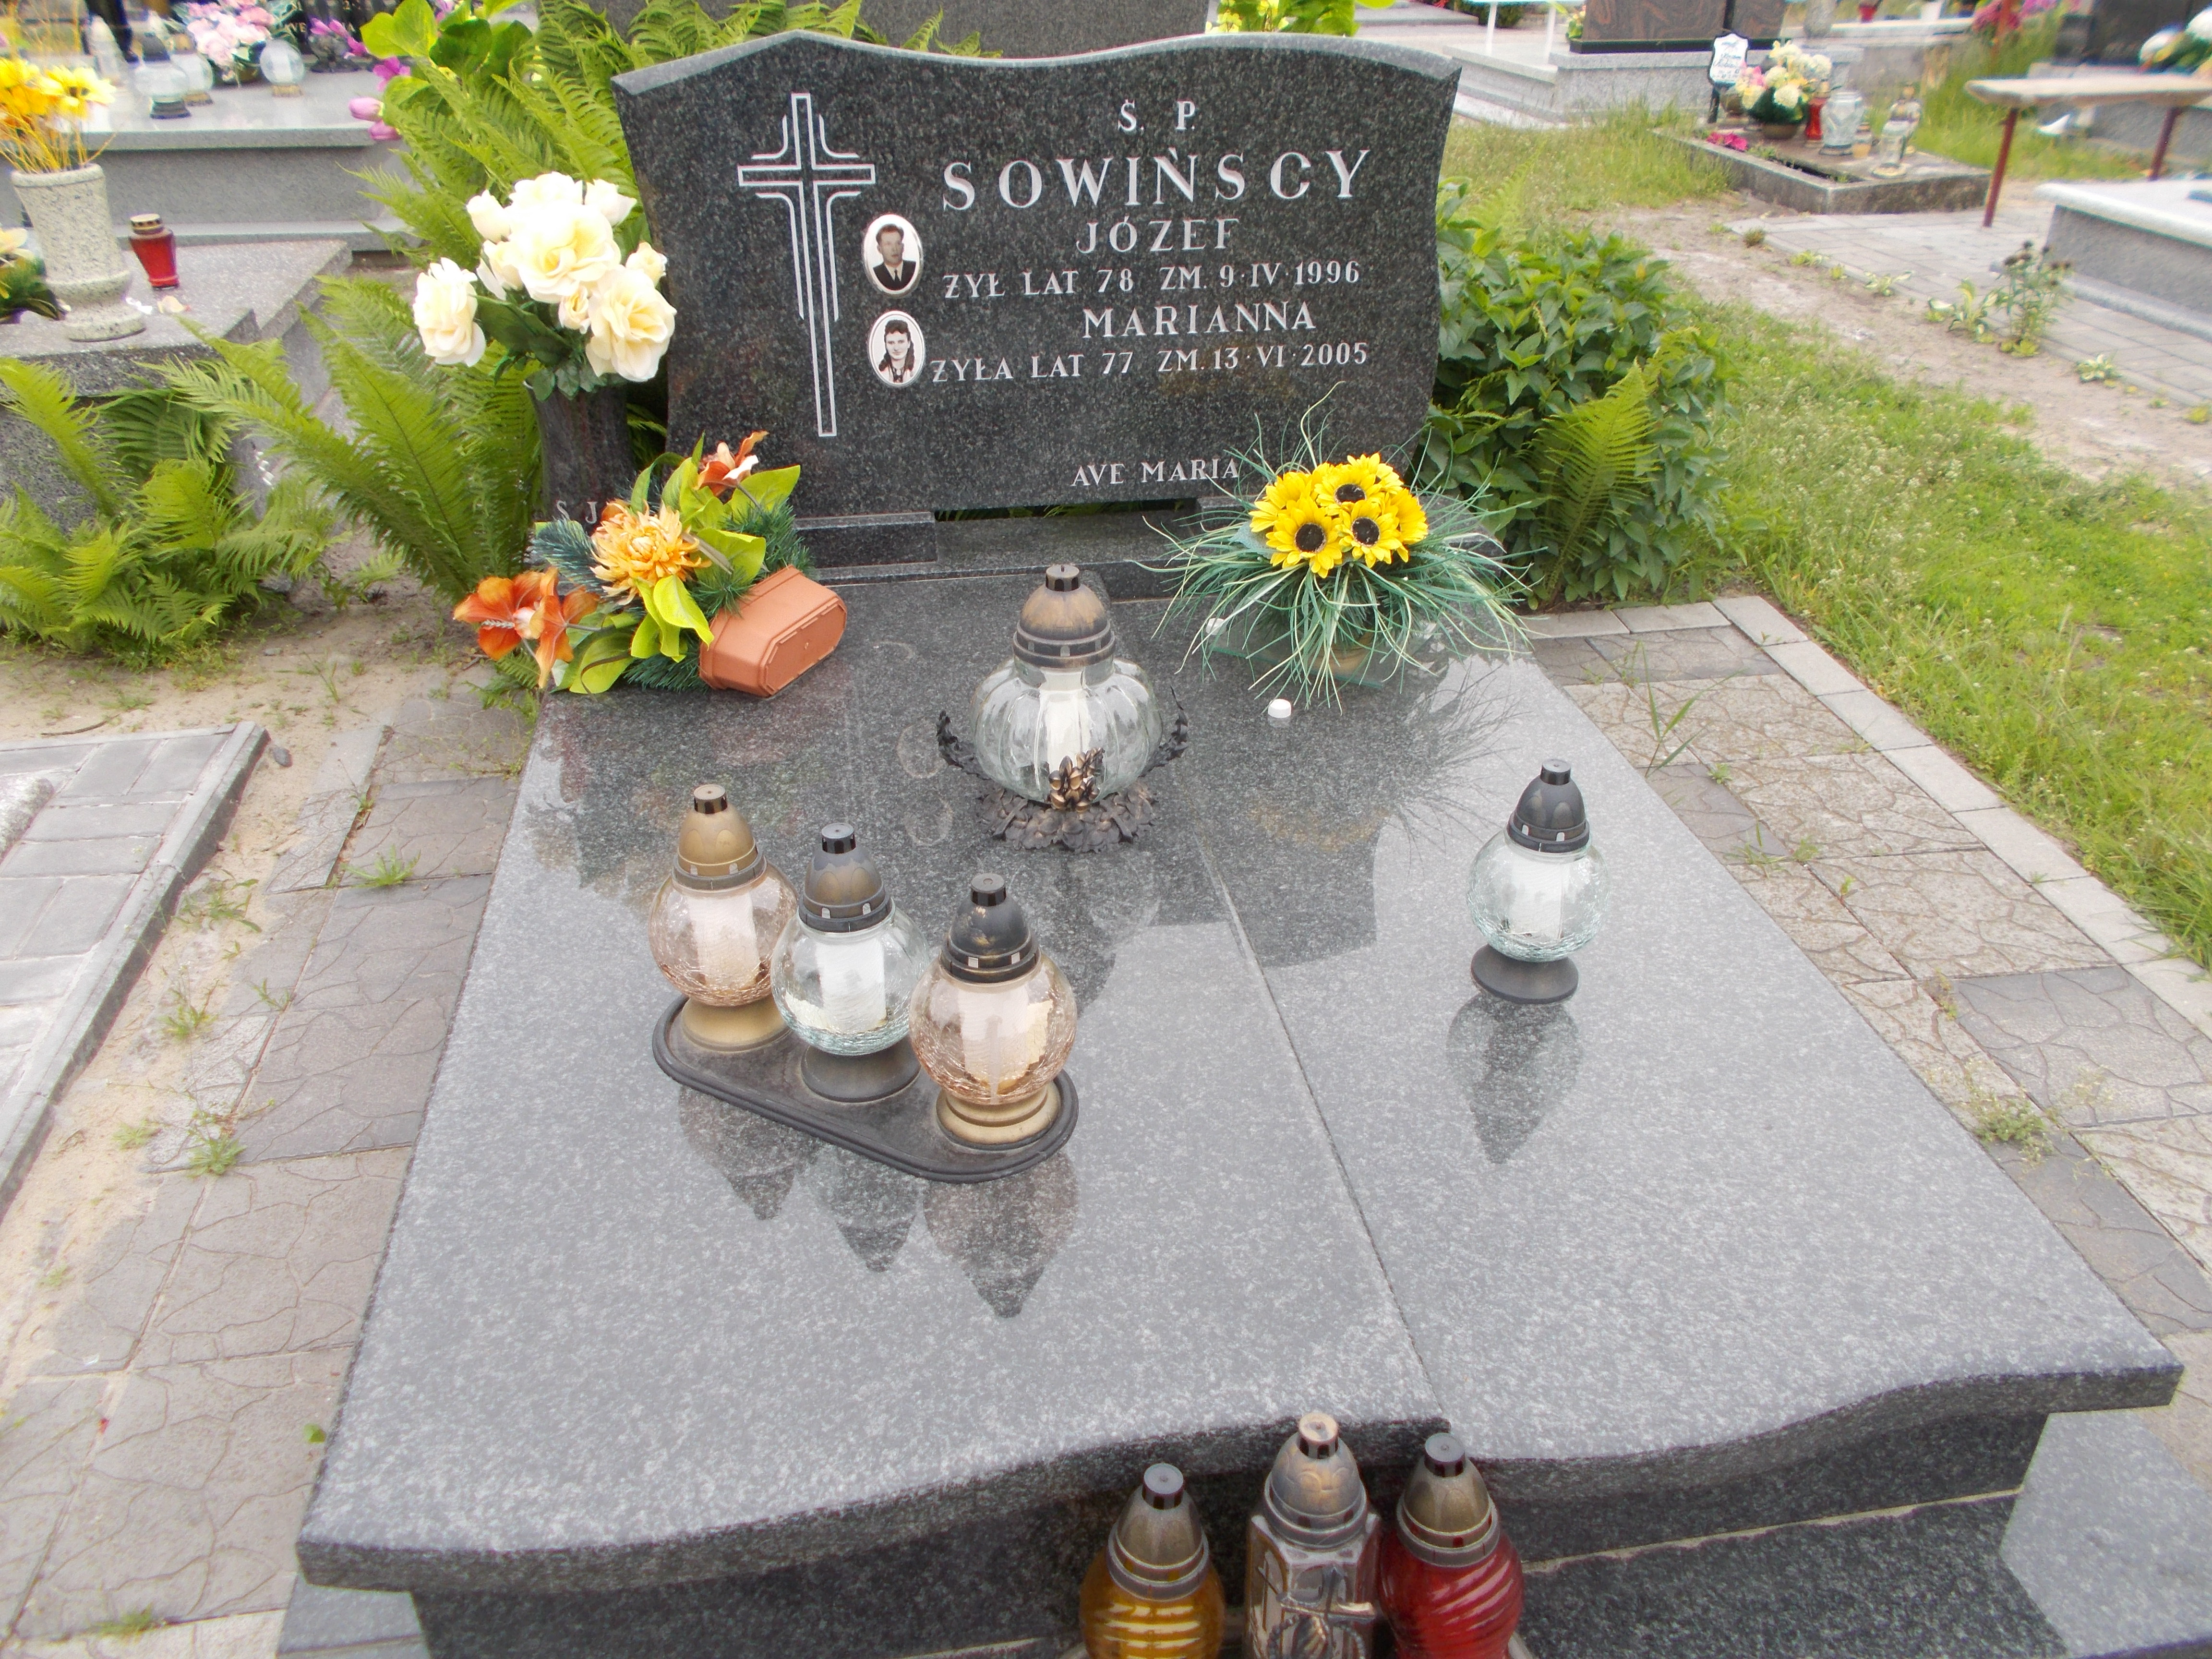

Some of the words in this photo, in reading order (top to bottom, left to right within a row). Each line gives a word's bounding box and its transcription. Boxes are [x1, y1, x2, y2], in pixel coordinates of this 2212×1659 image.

[943, 147, 1369, 210] SOWIŃSCY
[1076, 216, 1239, 254] JÓZEF
[1023, 270, 1079, 295] LAT
[1098, 268, 1133, 292] 78
[1082, 301, 1316, 338] MARIANNA
[1031, 354, 1084, 378] LAT
[1102, 351, 1133, 374] 77
[1071, 463, 1124, 486] AVE
[1141, 458, 1239, 482] MARIA
